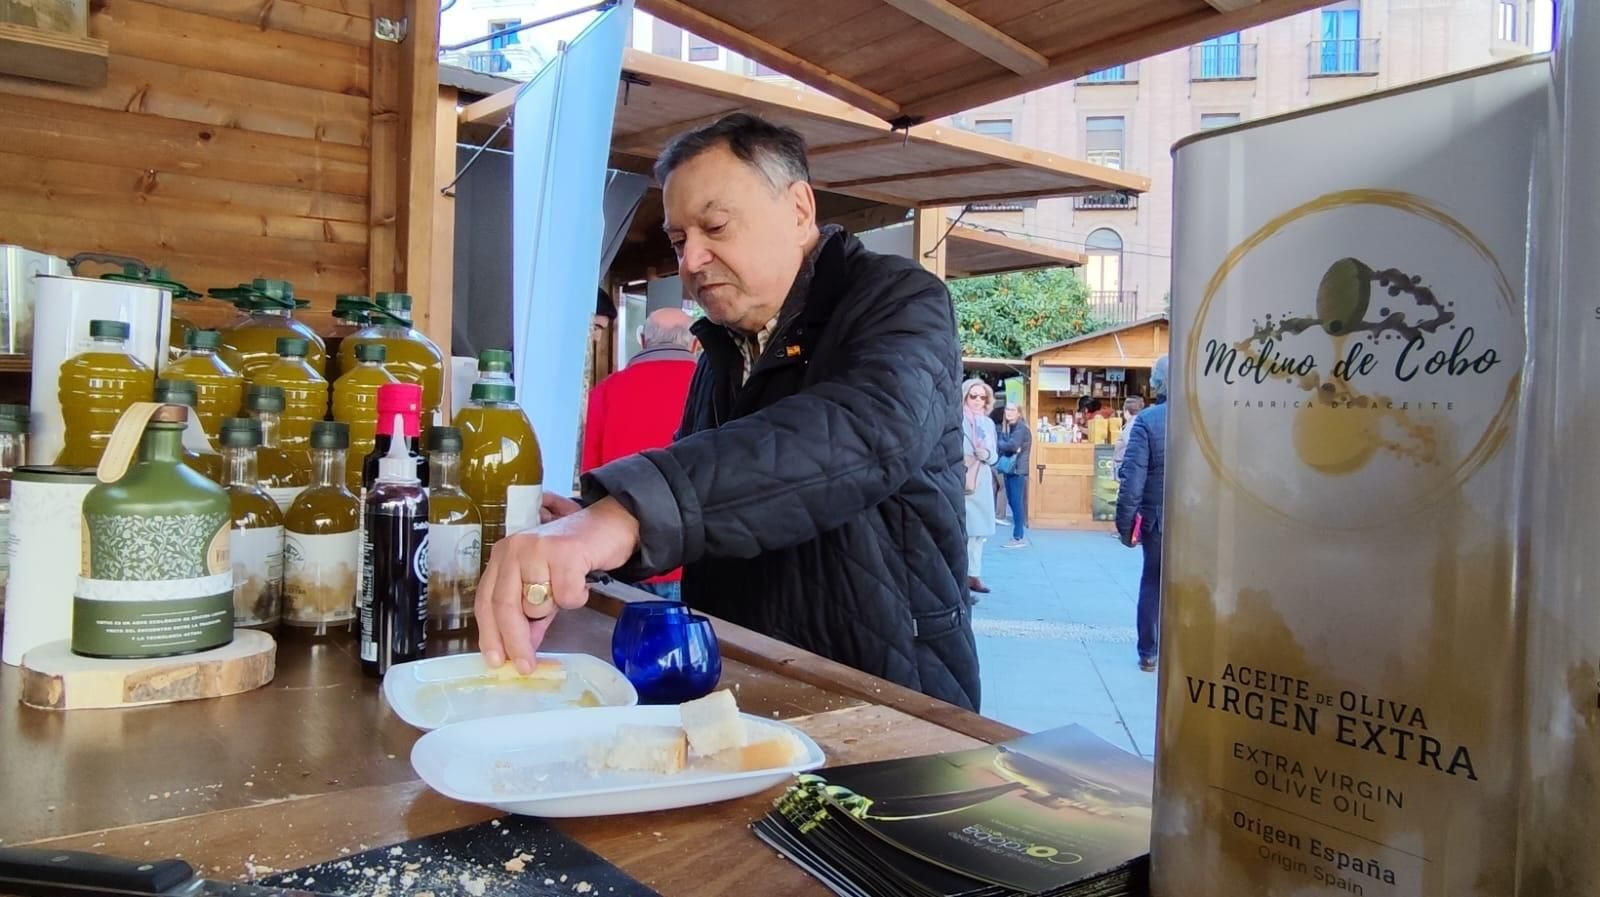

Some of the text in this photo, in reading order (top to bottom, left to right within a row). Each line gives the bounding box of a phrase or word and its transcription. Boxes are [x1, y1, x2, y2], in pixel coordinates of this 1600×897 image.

[1204, 326, 1501, 385] Molino de Cobo
[1331, 401, 1353, 410] DE
[1371, 401, 1454, 411] ACEITE
[1221, 663, 1428, 730] ACEITE DE OLIVA
[1186, 676, 1478, 781] VIRGEN EXTRA
[1233, 742, 1403, 809] EXTRA VIRGIN
[1254, 769, 1376, 823] OLIVE OIL
[1233, 811, 1396, 885] Origen España
[1258, 845, 1364, 897] Origin Spain
